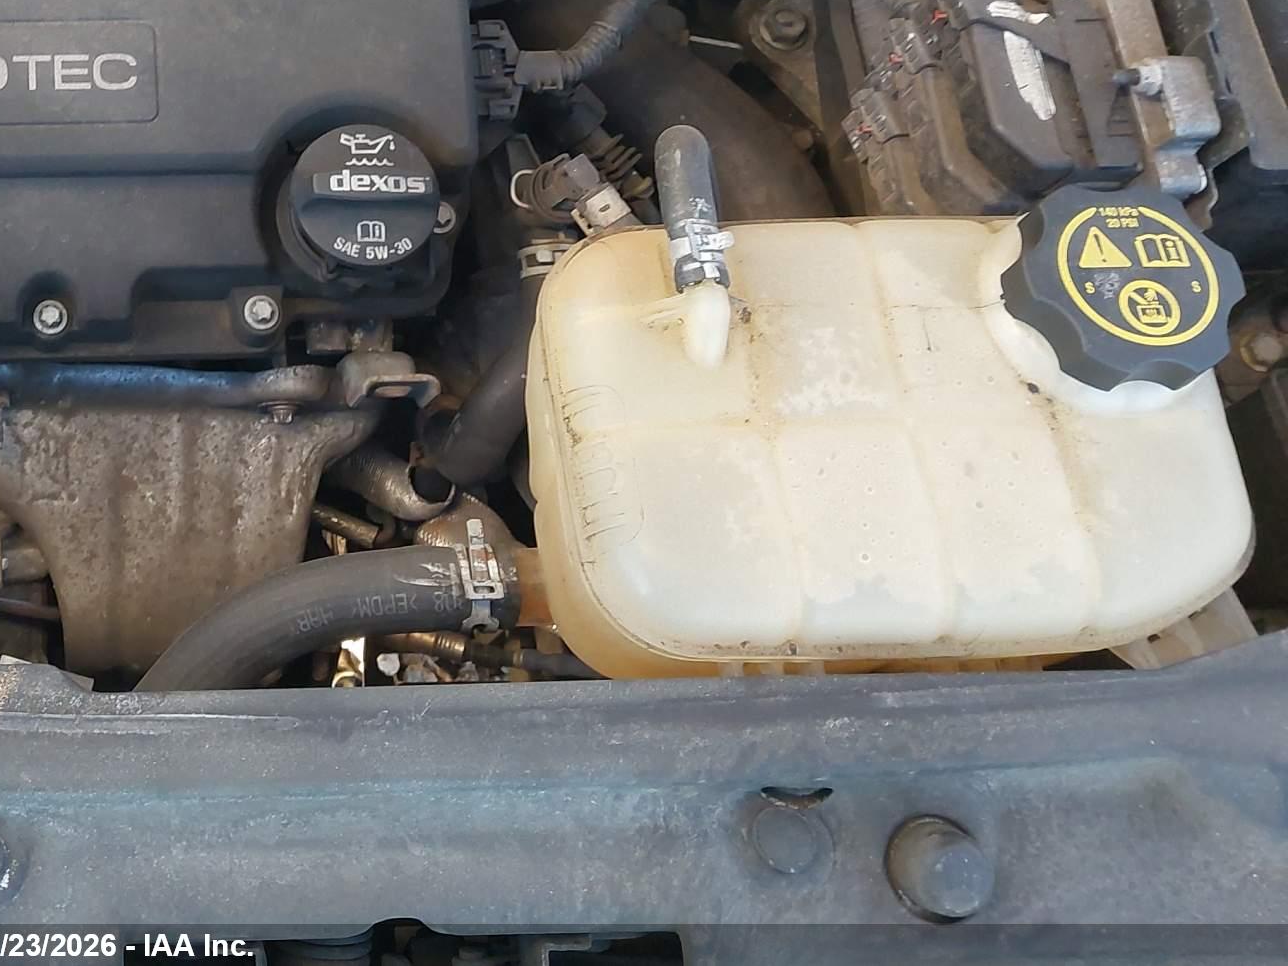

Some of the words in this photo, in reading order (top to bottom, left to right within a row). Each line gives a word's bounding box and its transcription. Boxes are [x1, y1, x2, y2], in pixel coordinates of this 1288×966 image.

[329, 169, 426, 194] dexos
[1105, 218, 1121, 228] 20
[333, 236, 361, 258] SAE
[365, 237, 413, 260] 5W-30
